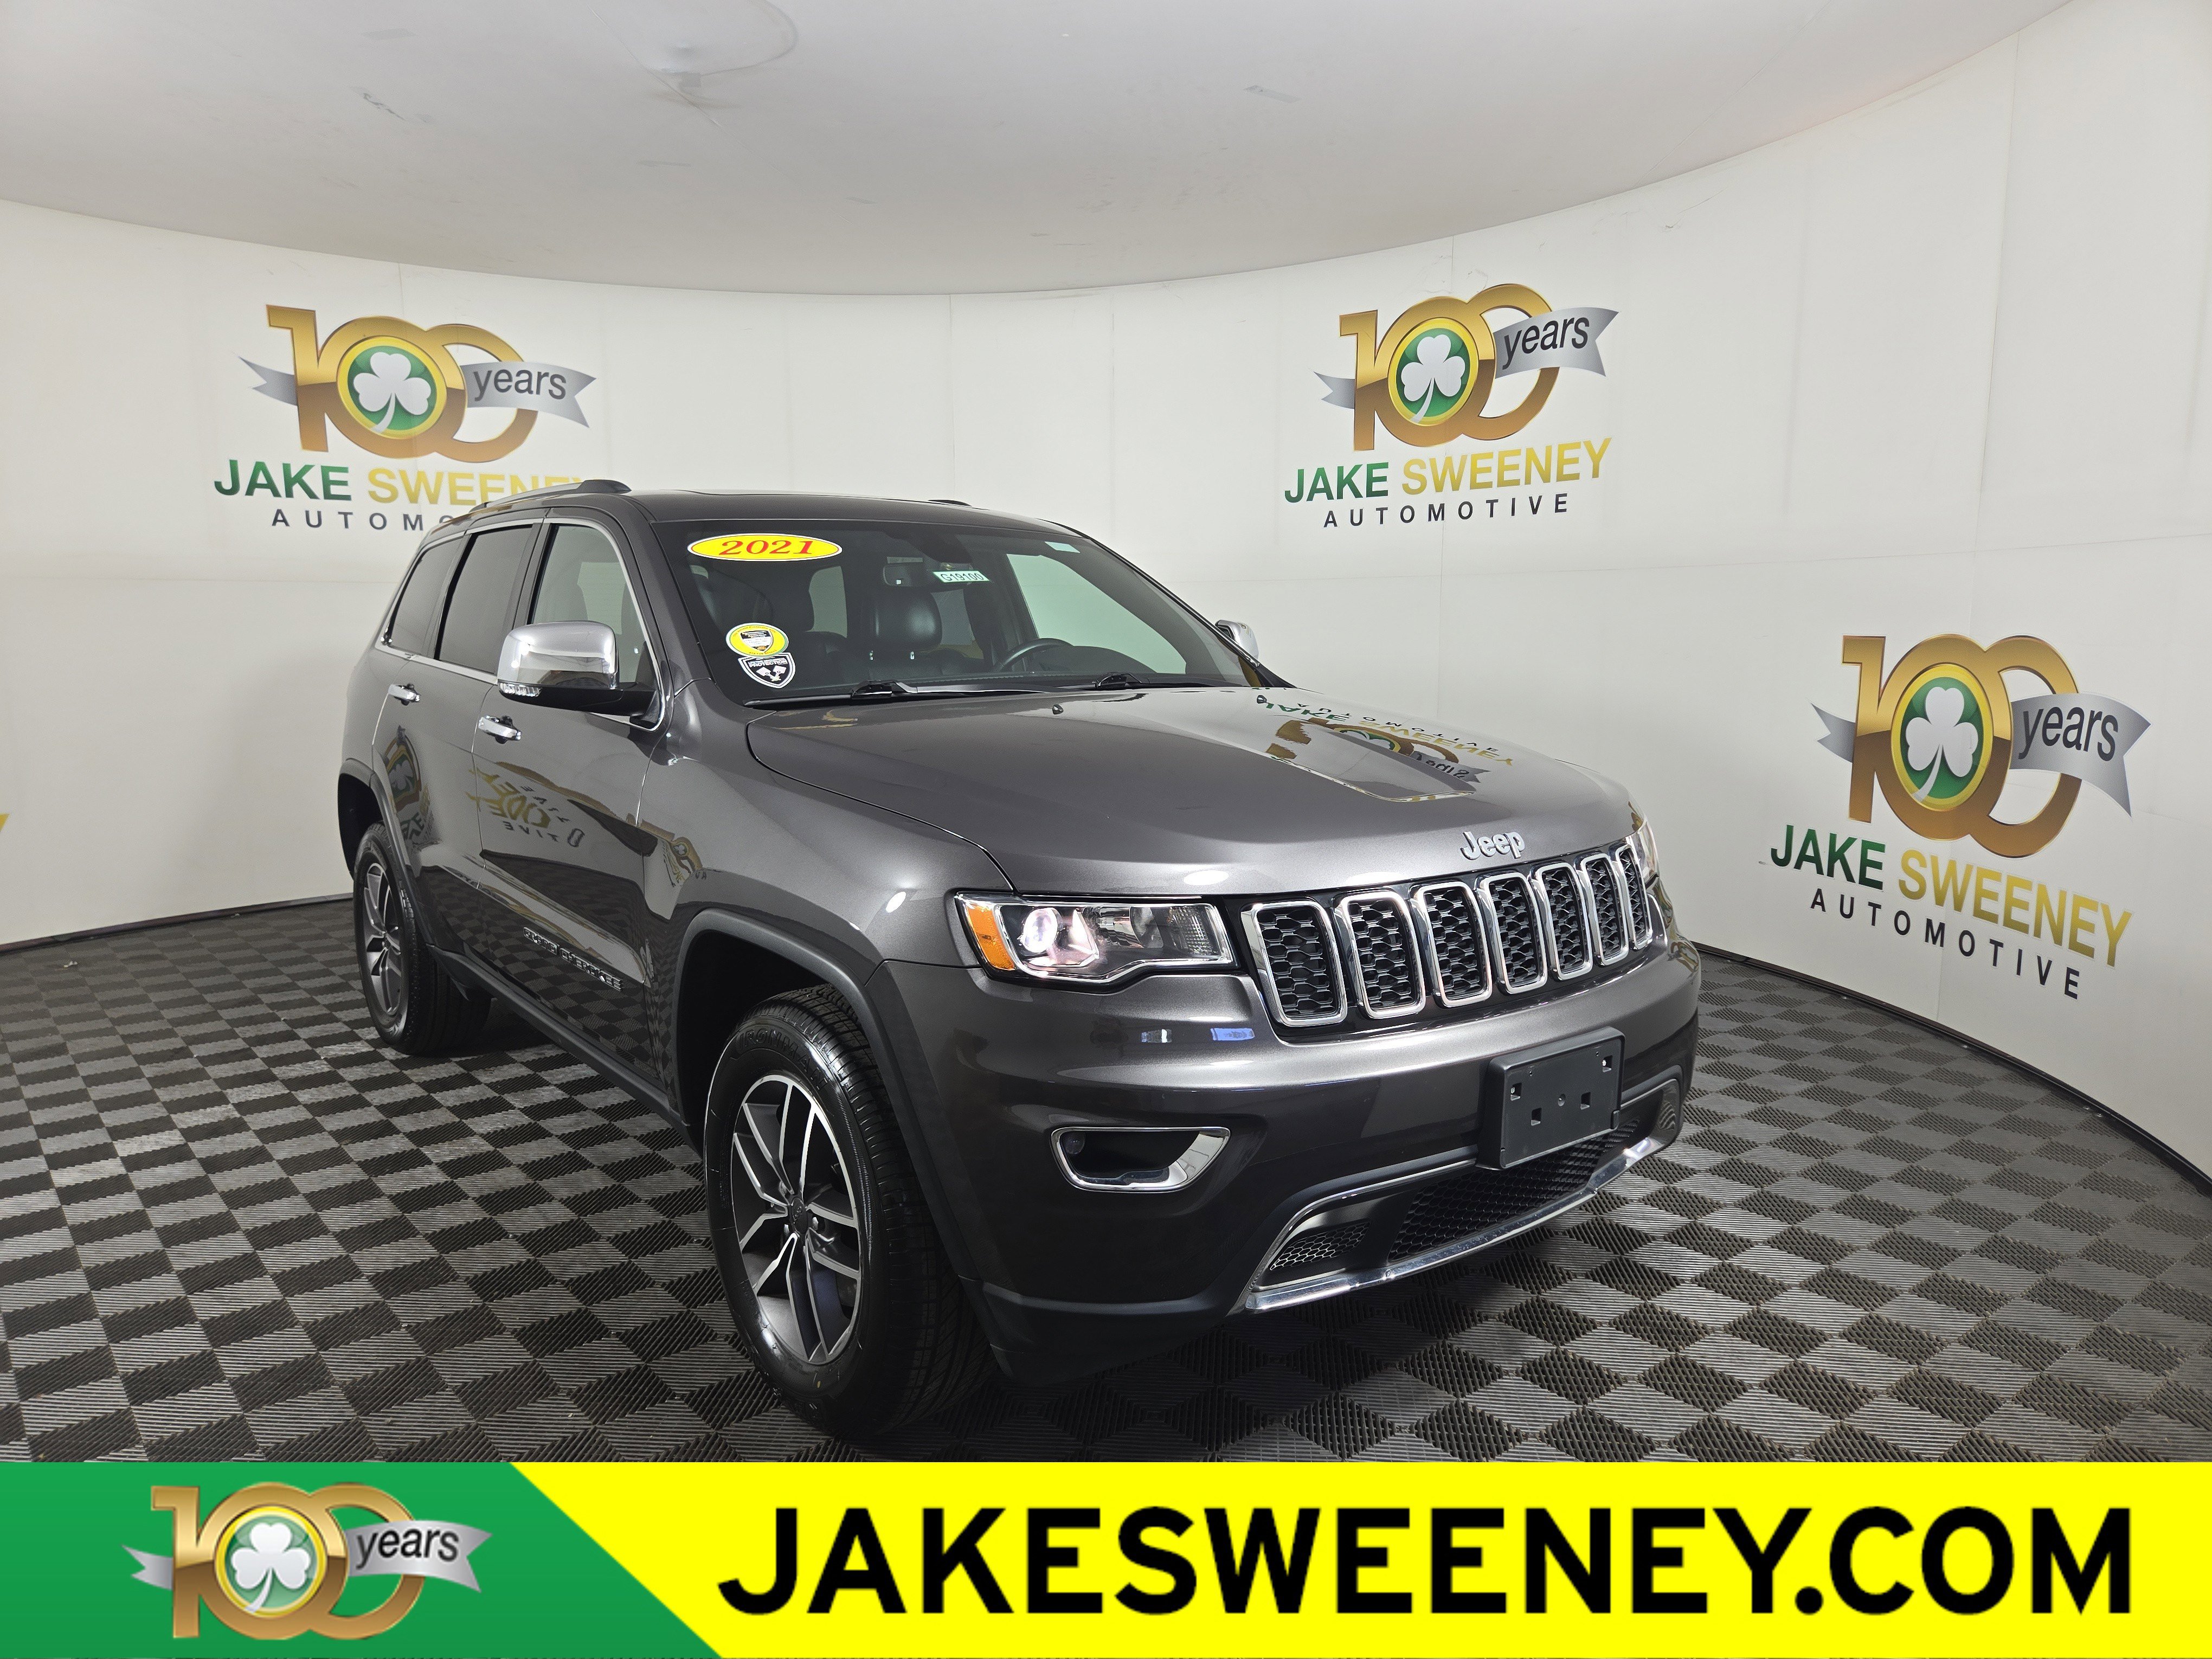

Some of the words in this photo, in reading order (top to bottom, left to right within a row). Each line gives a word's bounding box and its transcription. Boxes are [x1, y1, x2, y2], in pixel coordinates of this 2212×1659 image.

[1339, 283, 1560, 452] 100
[1502, 316, 1589, 370] years
[266, 304, 539, 463] 100
[473, 366, 567, 401] years
[214, 459, 352, 501] JAKE
[1284, 462, 1389, 503] JAKE
[1402, 438, 1612, 496] SWEENEY
[1323, 493, 1568, 528] AUTOMOTIVE
[718, 540, 813, 555] 2021
[941, 573, 984, 581] G19100
[1842, 634, 2081, 858] 100
[2018, 706, 2118, 761] years
[1460, 831, 1525, 860] Jeep
[1771, 825, 1886, 890] JAKE
[1899, 850, 2132, 969] SWEENEY
[1810, 888, 2080, 1000] AUTOMOTIVE
